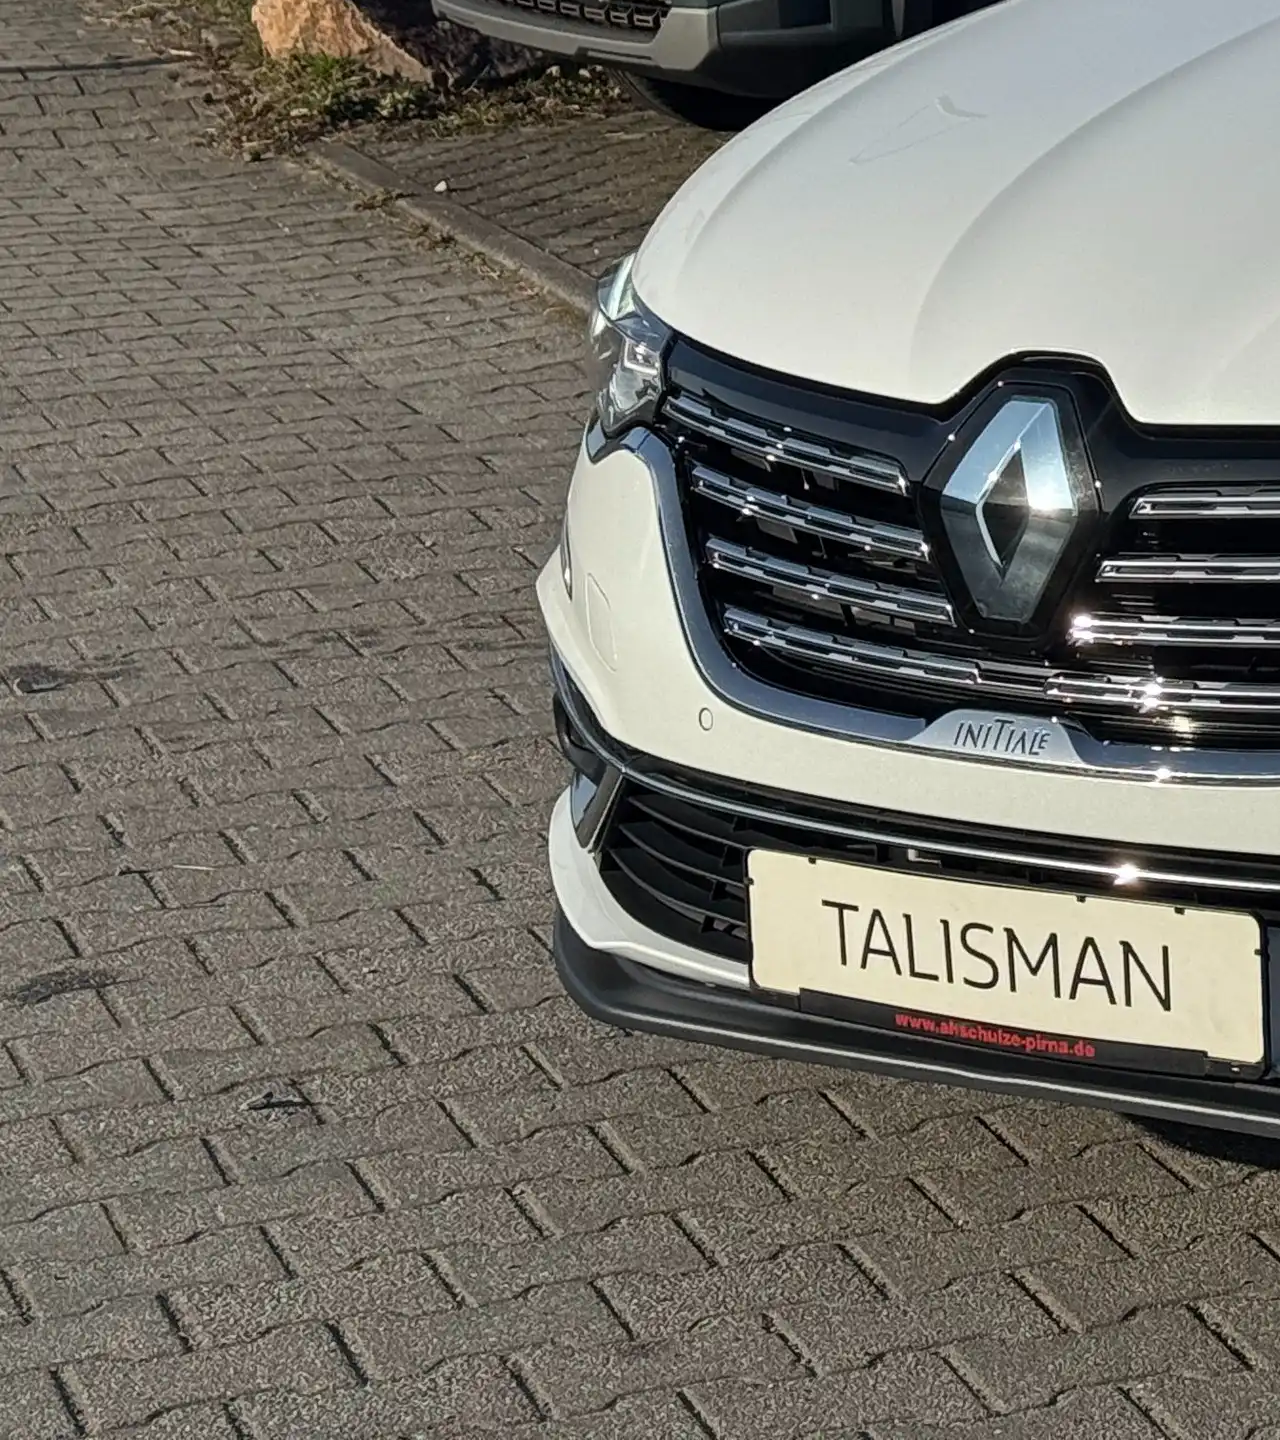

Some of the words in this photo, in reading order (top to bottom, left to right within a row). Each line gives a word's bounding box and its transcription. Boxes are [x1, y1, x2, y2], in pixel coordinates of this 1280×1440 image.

[953, 716, 1052, 757] INITIALE
[820, 898, 1173, 1012] TALISMAN
[894, 1013, 1096, 1058] www.ahschulze-pirna.de
